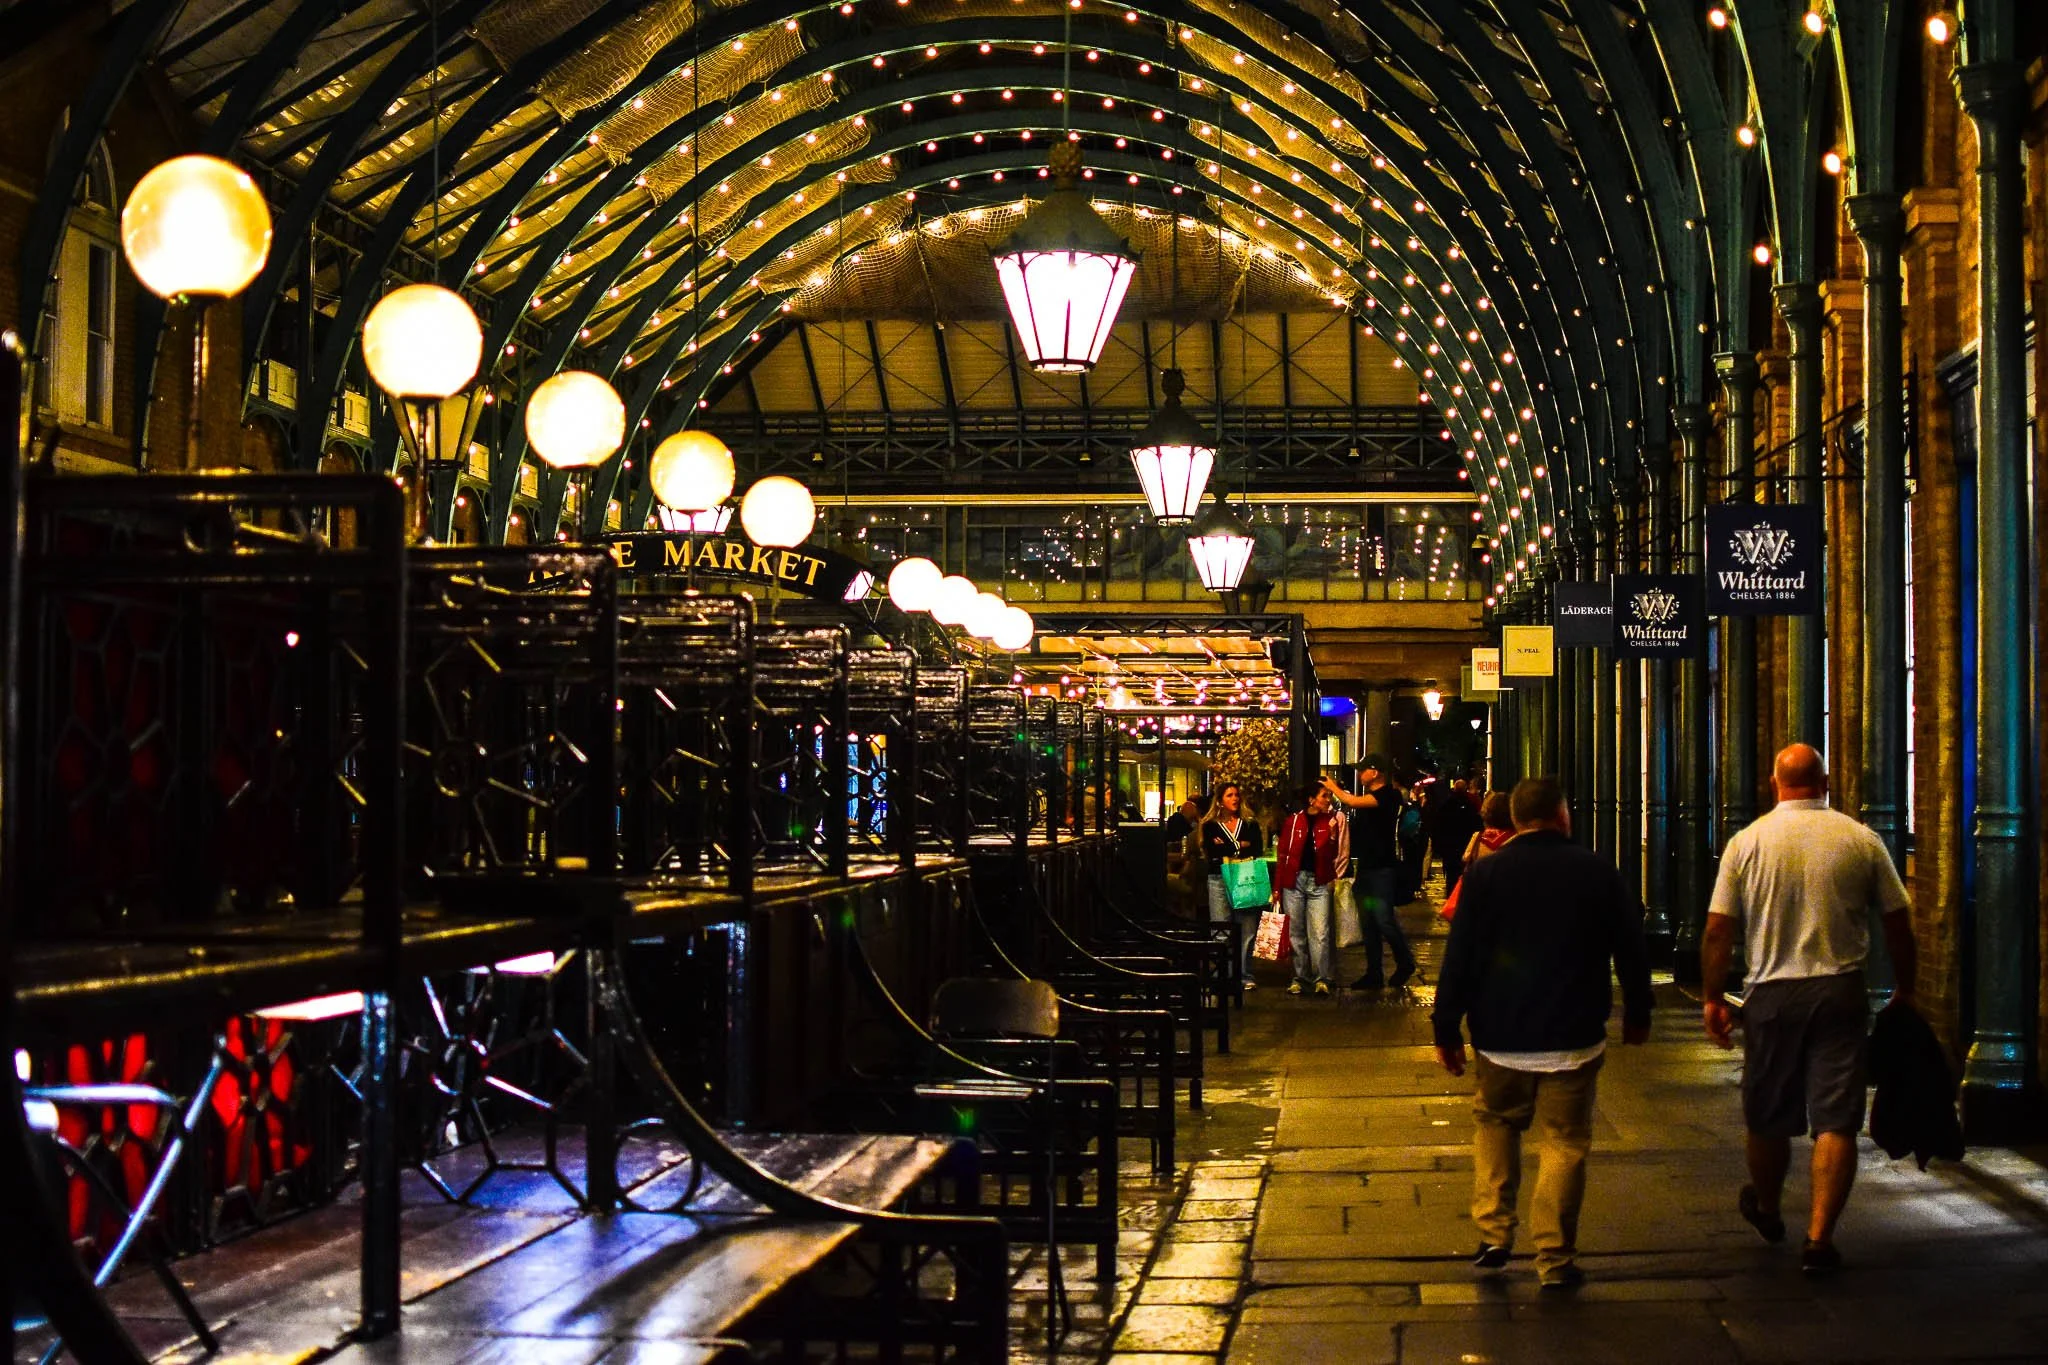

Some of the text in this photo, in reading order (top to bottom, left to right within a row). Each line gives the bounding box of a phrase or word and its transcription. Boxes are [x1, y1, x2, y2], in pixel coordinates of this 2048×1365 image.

[663, 540, 826, 586] MARKET
[1718, 571, 1805, 590] Whittard
[1730, 592, 1795, 600] CHELSEA 1886
[1622, 625, 1687, 640] Whittard
